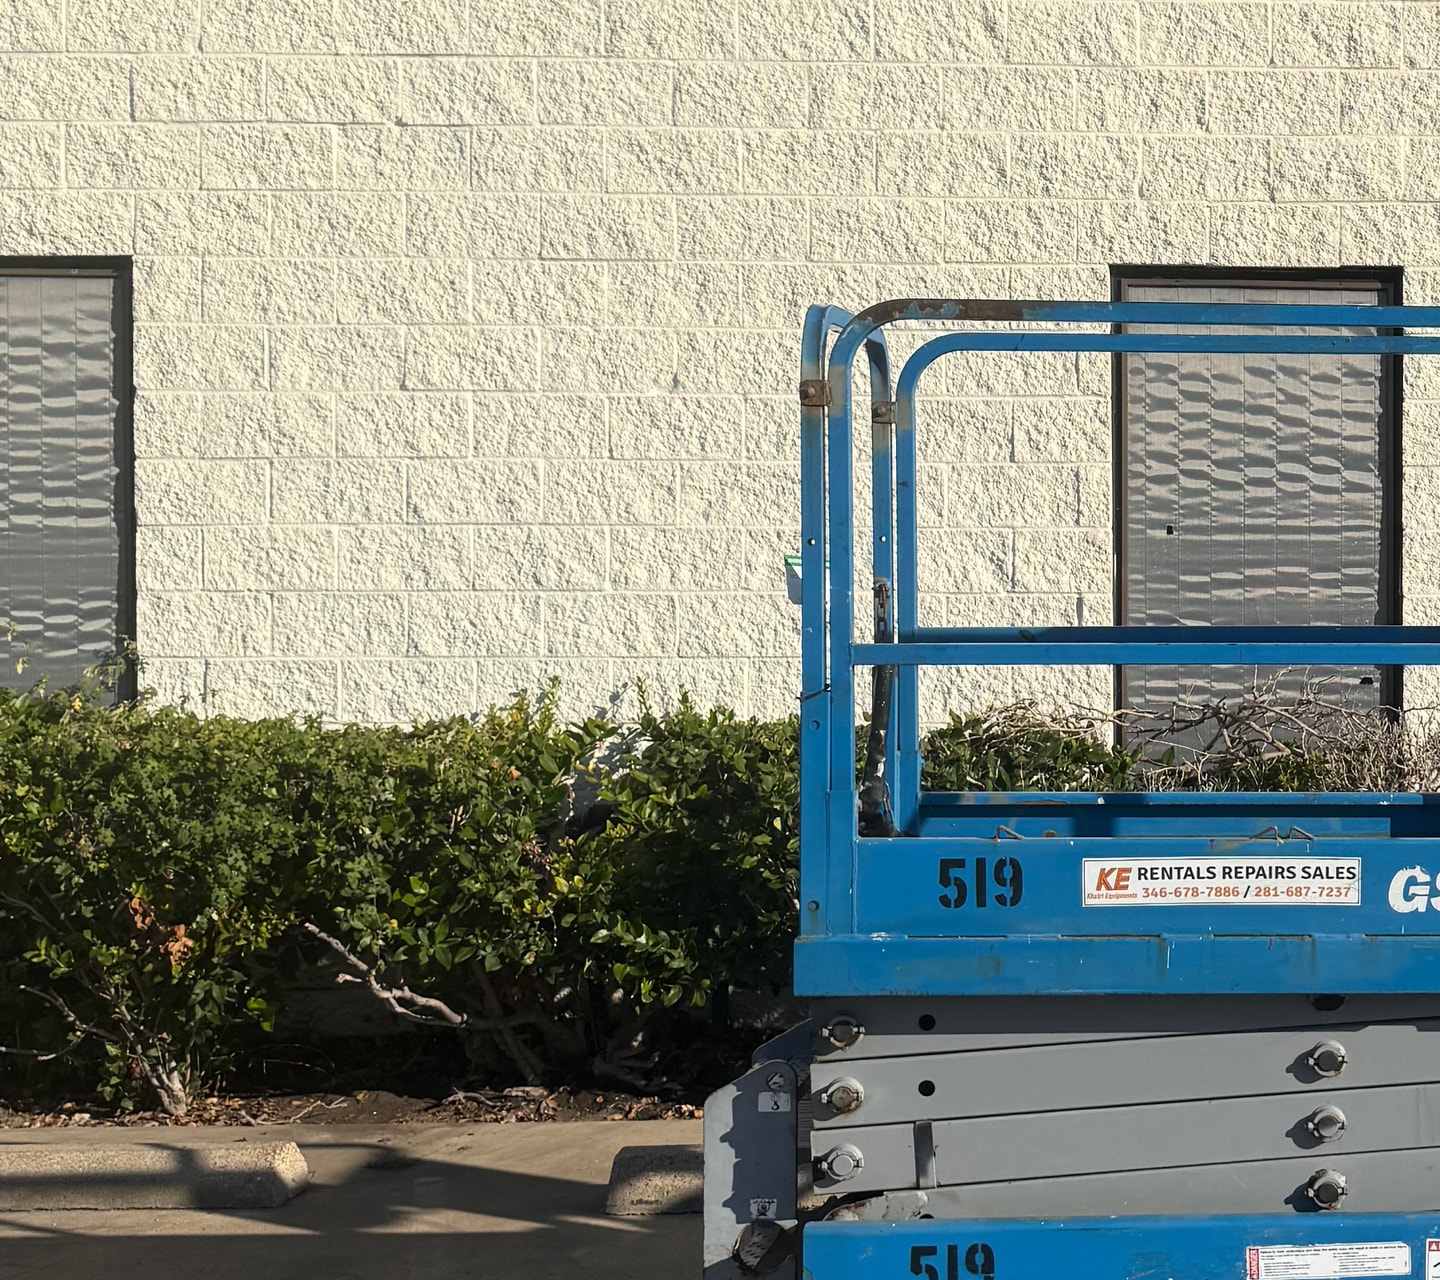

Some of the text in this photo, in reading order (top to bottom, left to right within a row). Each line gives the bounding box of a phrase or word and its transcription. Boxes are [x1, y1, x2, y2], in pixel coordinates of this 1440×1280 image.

[939, 857, 1023, 908] 519
[1095, 867, 1133, 891] KE
[1137, 865, 1357, 881] RENTALS REPAIRS SALES
[1141, 886, 1240, 898] 346-678-7886
[1254, 886, 1351, 898] 281-687-7237
